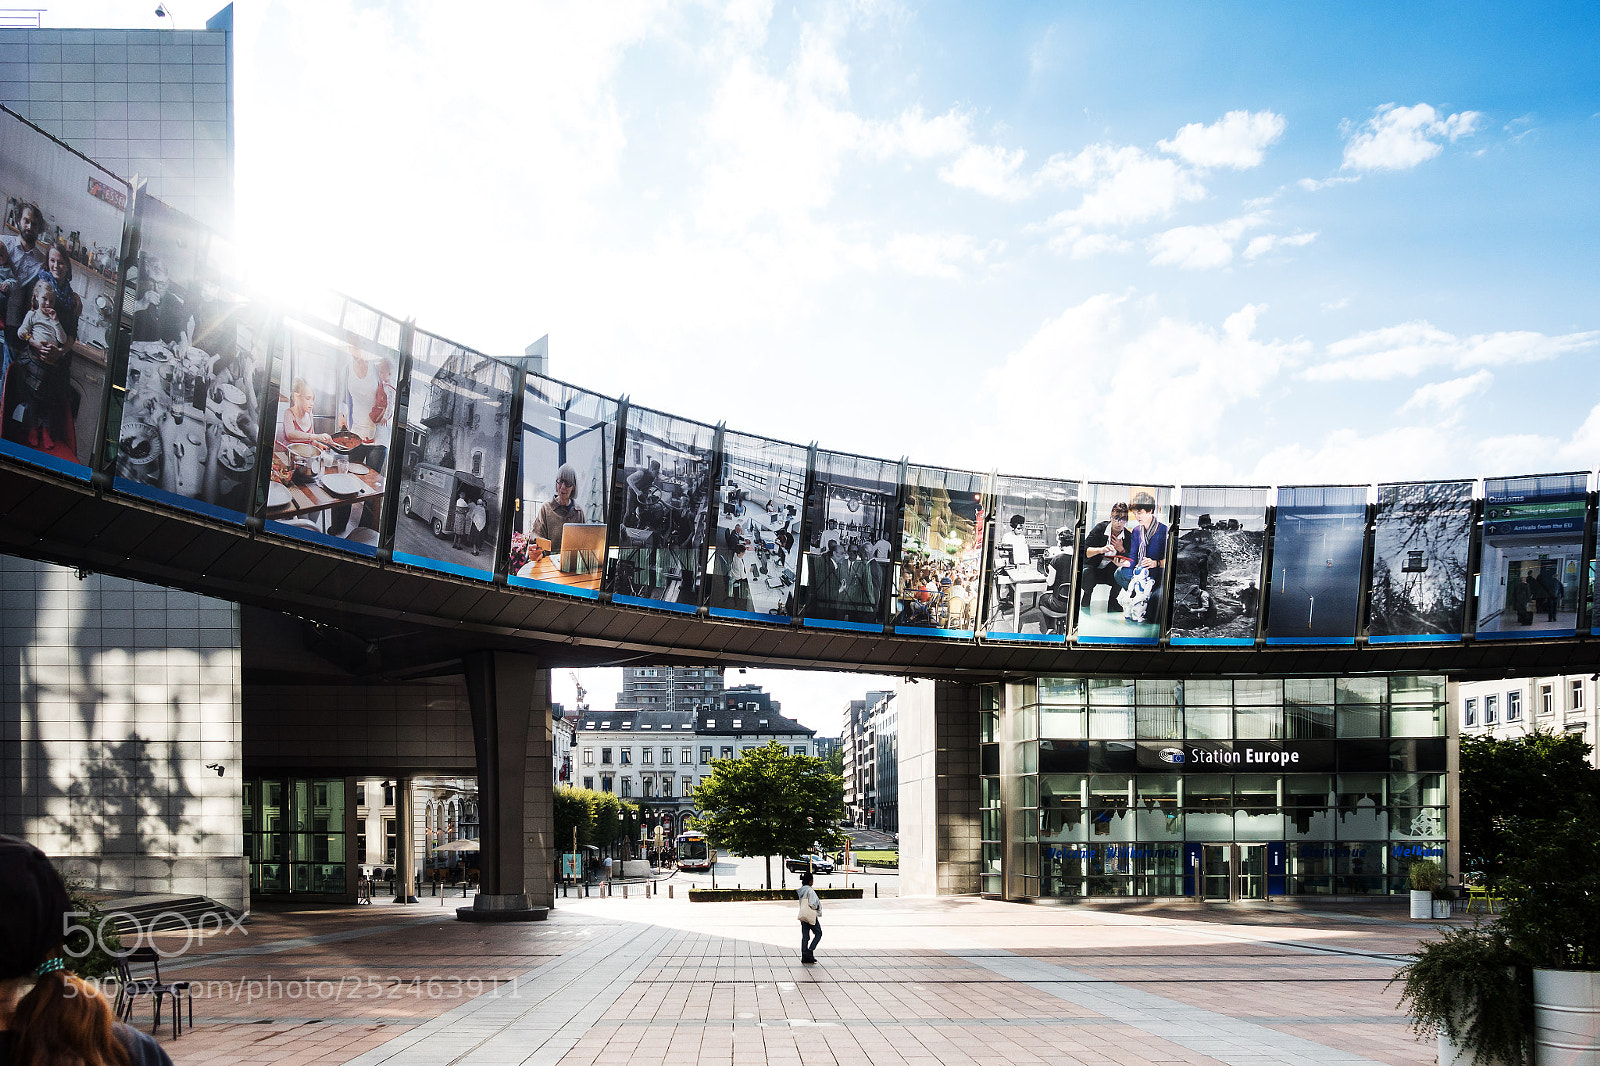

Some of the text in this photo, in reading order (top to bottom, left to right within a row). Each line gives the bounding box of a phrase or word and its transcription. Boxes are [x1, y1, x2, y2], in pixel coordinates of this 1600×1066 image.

[1488, 496, 1525, 504] Customs
[1191, 748, 1300, 767] Station Europe
[1046, 846, 1179, 859] Welcome Willkommen
[1301, 846, 1367, 857] Bienvenue
[1392, 845, 1444, 857] Welkom
